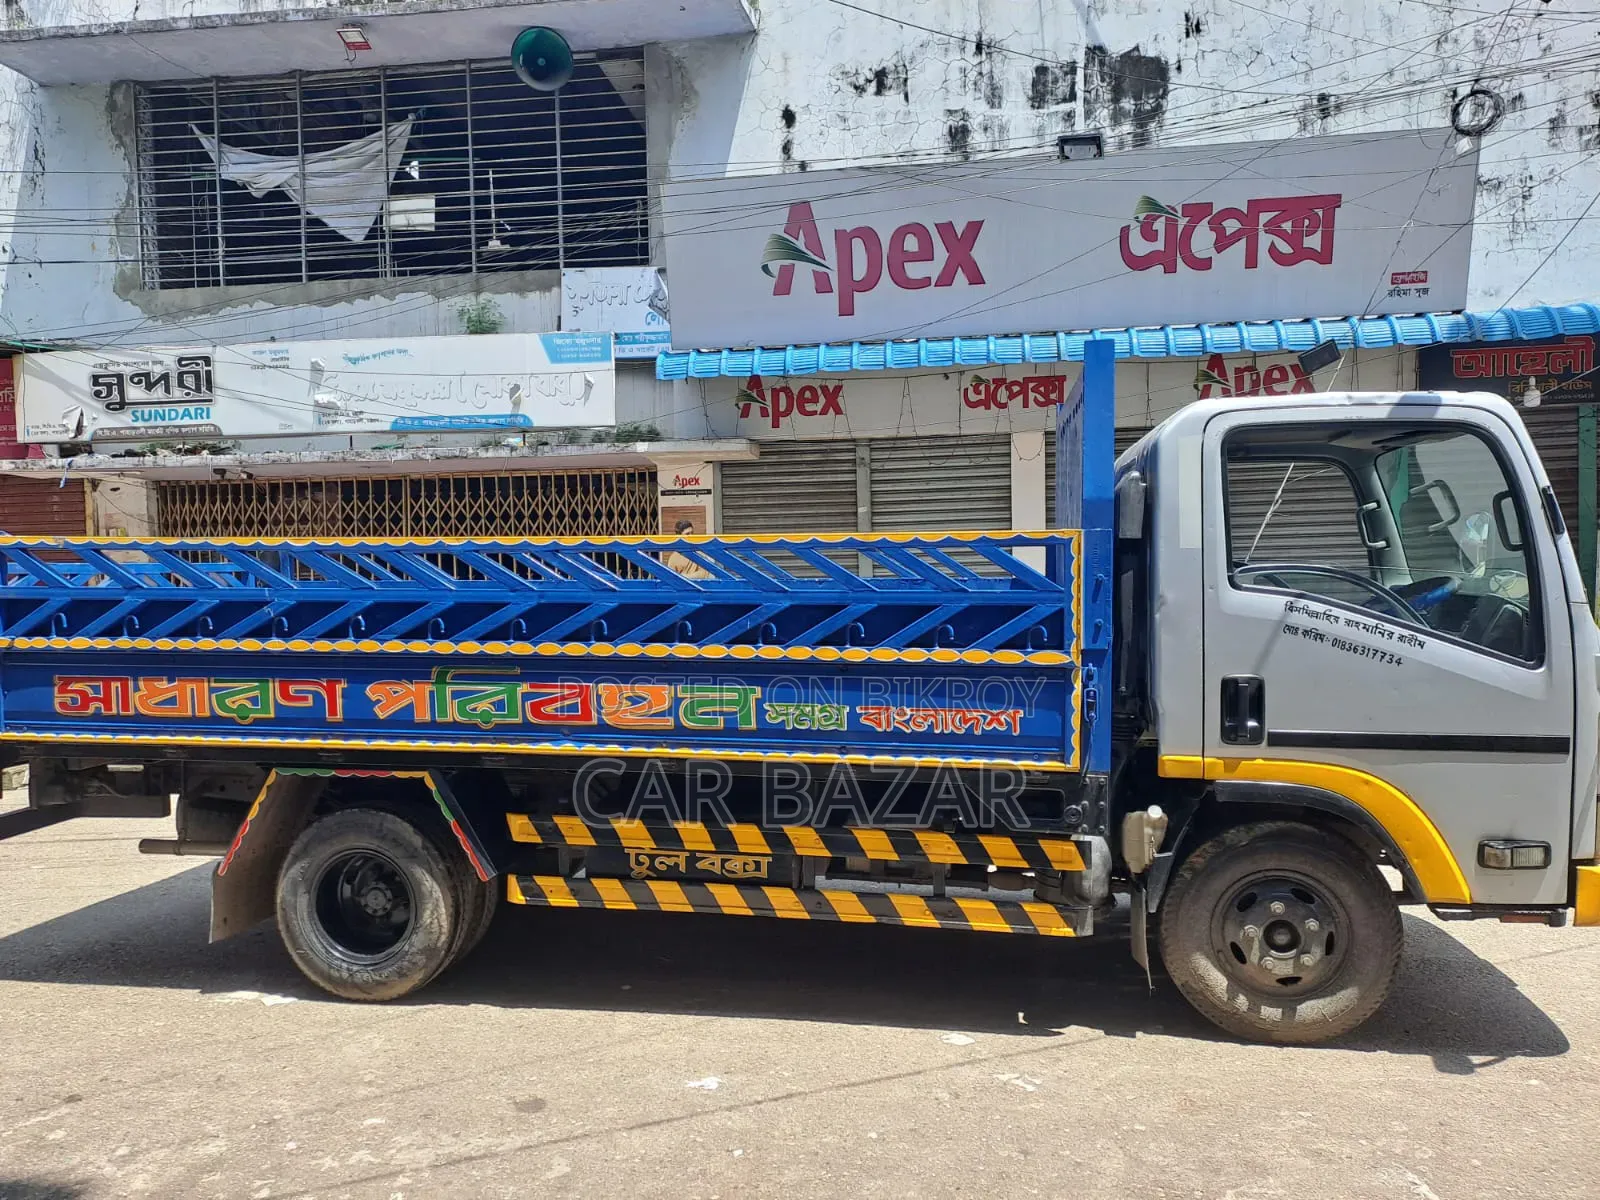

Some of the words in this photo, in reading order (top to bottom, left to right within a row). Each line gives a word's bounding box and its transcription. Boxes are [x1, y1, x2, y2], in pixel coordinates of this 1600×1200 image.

[1120, 194, 1342, 273] এপেক্স
[772, 200, 986, 317] Apex
[91, 355, 214, 411] সুন্দরী
[740, 374, 843, 428] Apex
[963, 375, 1067, 410] এপেক্স
[131, 407, 211, 423] SUNDARI
[674, 475, 700, 488] Apex
[1331, 637, 1404, 667] 01836317734
[53, 674, 347, 724] সাধারণ
[365, 665, 761, 730] পরিবহন
[764, 702, 850, 731] সমগ্র
[856, 705, 1024, 735] বাংলাদেশ
[695, 853, 773, 879] বক্স
